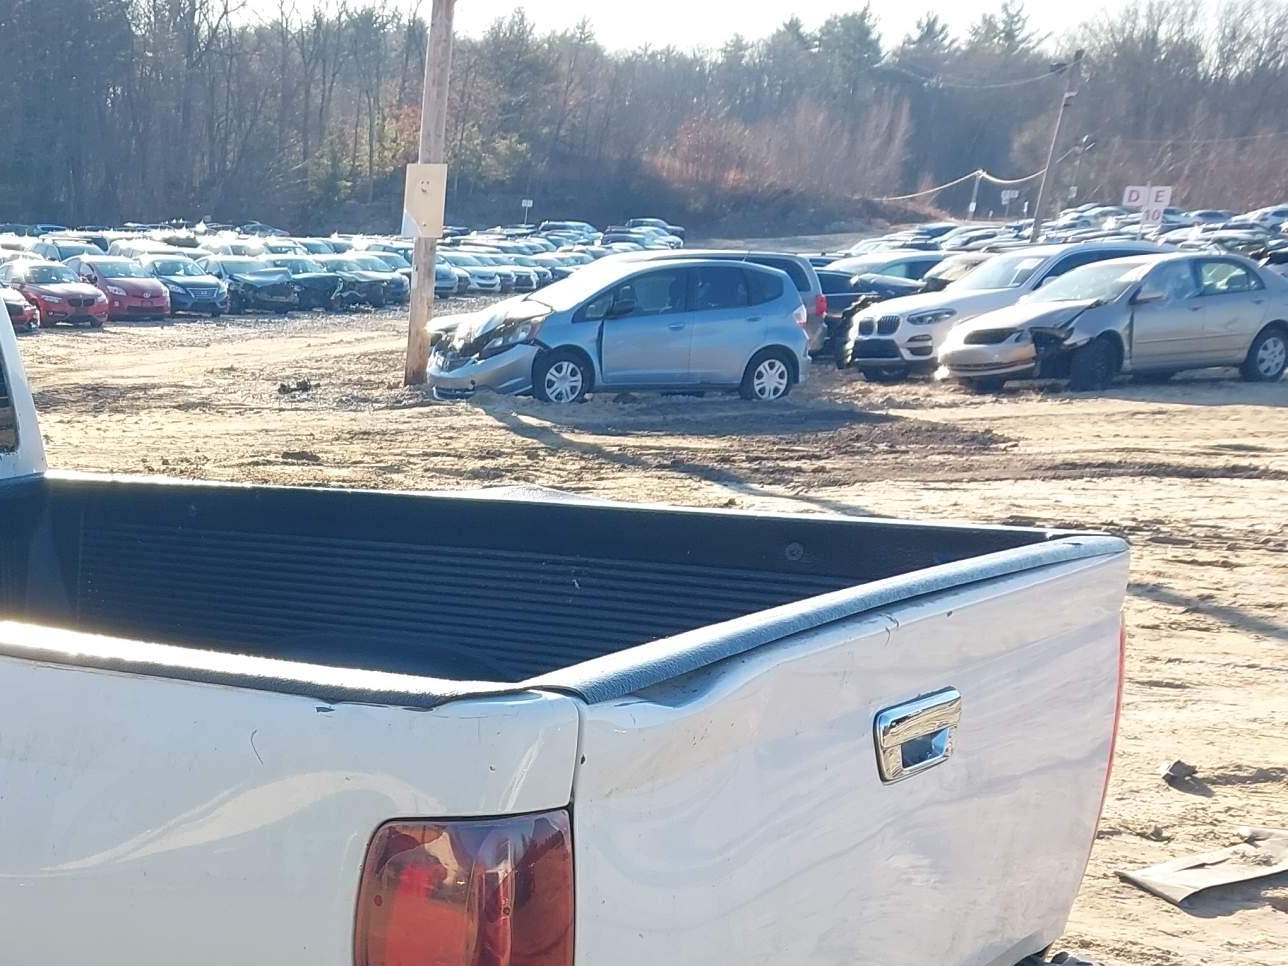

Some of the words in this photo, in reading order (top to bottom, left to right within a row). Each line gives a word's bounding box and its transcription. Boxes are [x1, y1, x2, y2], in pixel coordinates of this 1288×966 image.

[1127, 189, 1140, 203] D
[1154, 189, 1166, 203] E
[1144, 208, 1161, 221] 10
